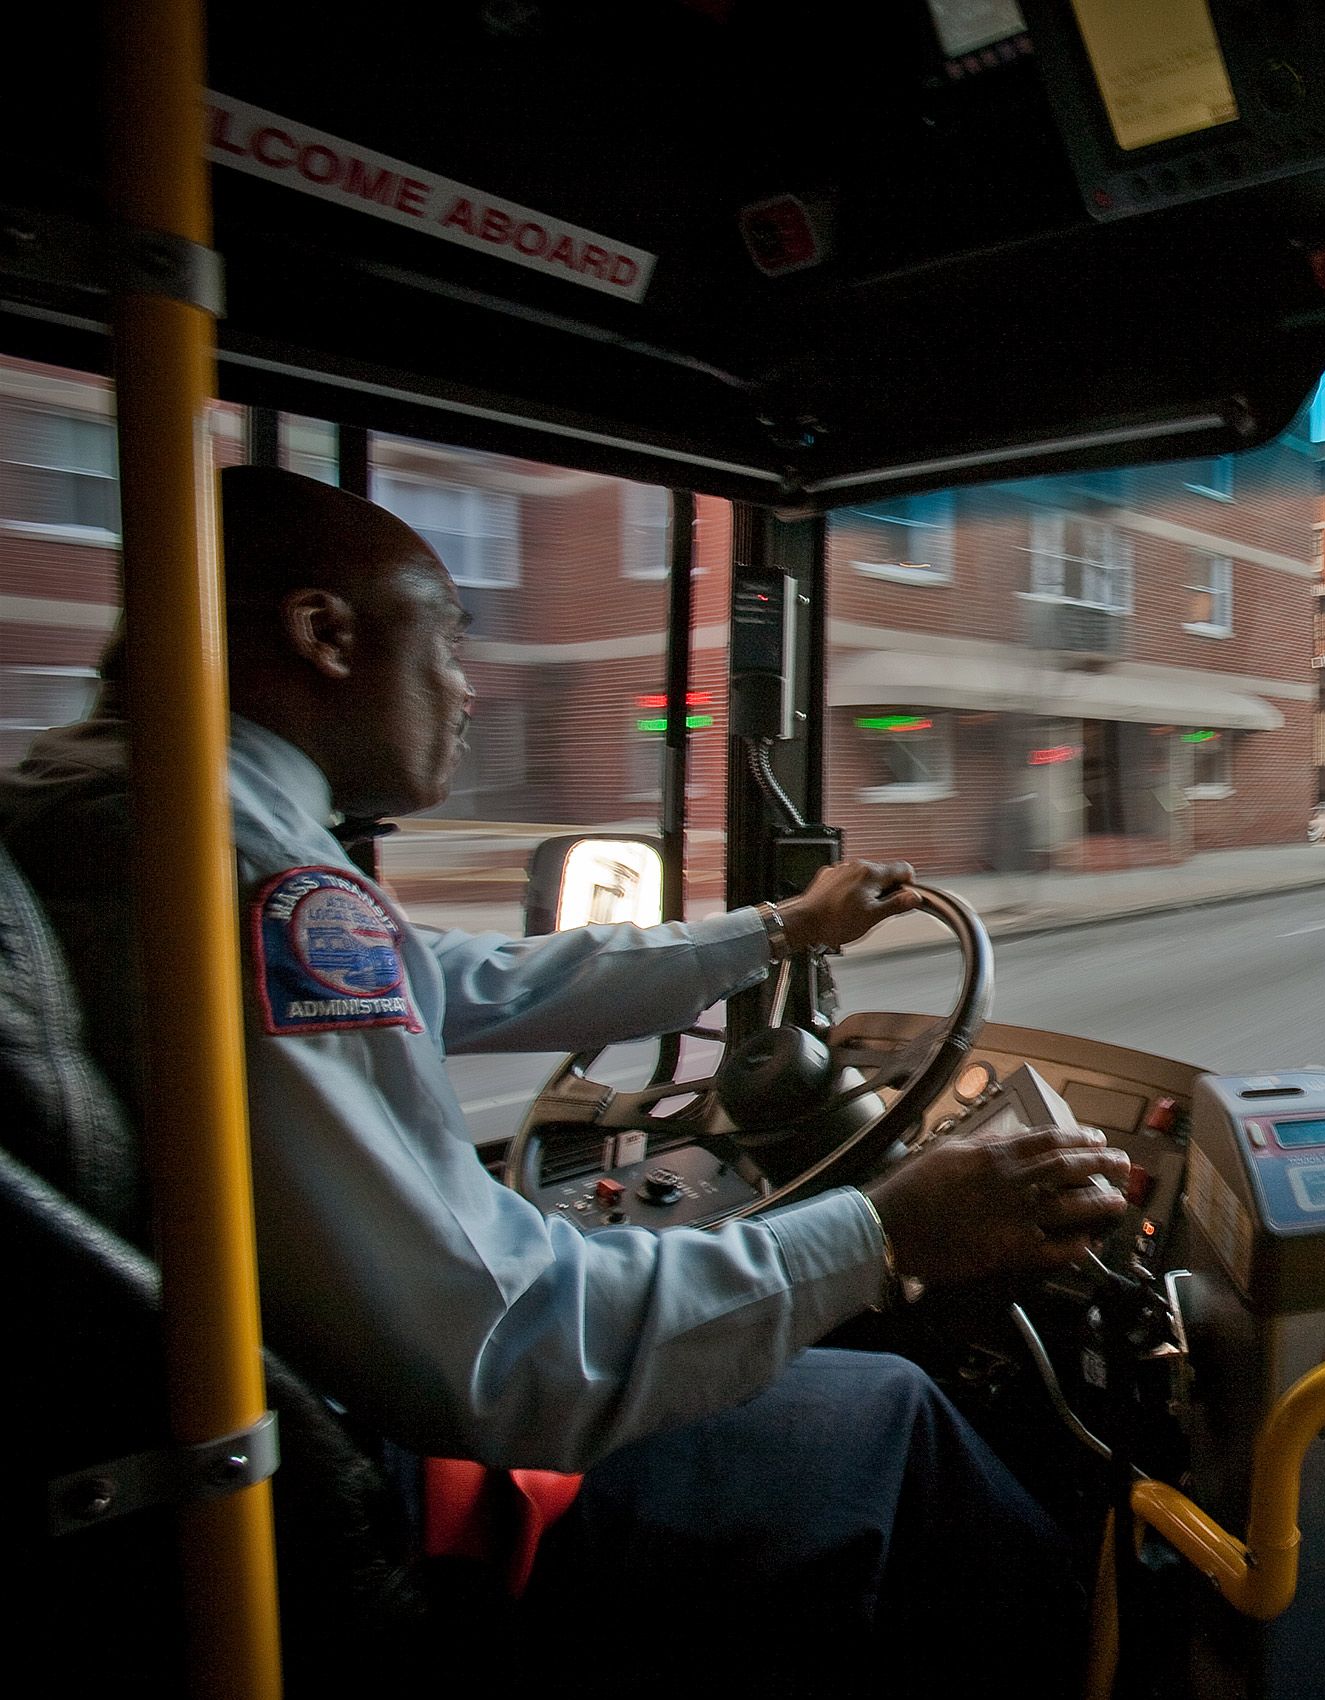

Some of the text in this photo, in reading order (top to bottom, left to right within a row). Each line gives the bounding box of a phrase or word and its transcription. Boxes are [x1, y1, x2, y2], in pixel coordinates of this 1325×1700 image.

[207, 105, 640, 288] LCOME ABOARD
[267, 874, 399, 935] MASS TRANSIT
